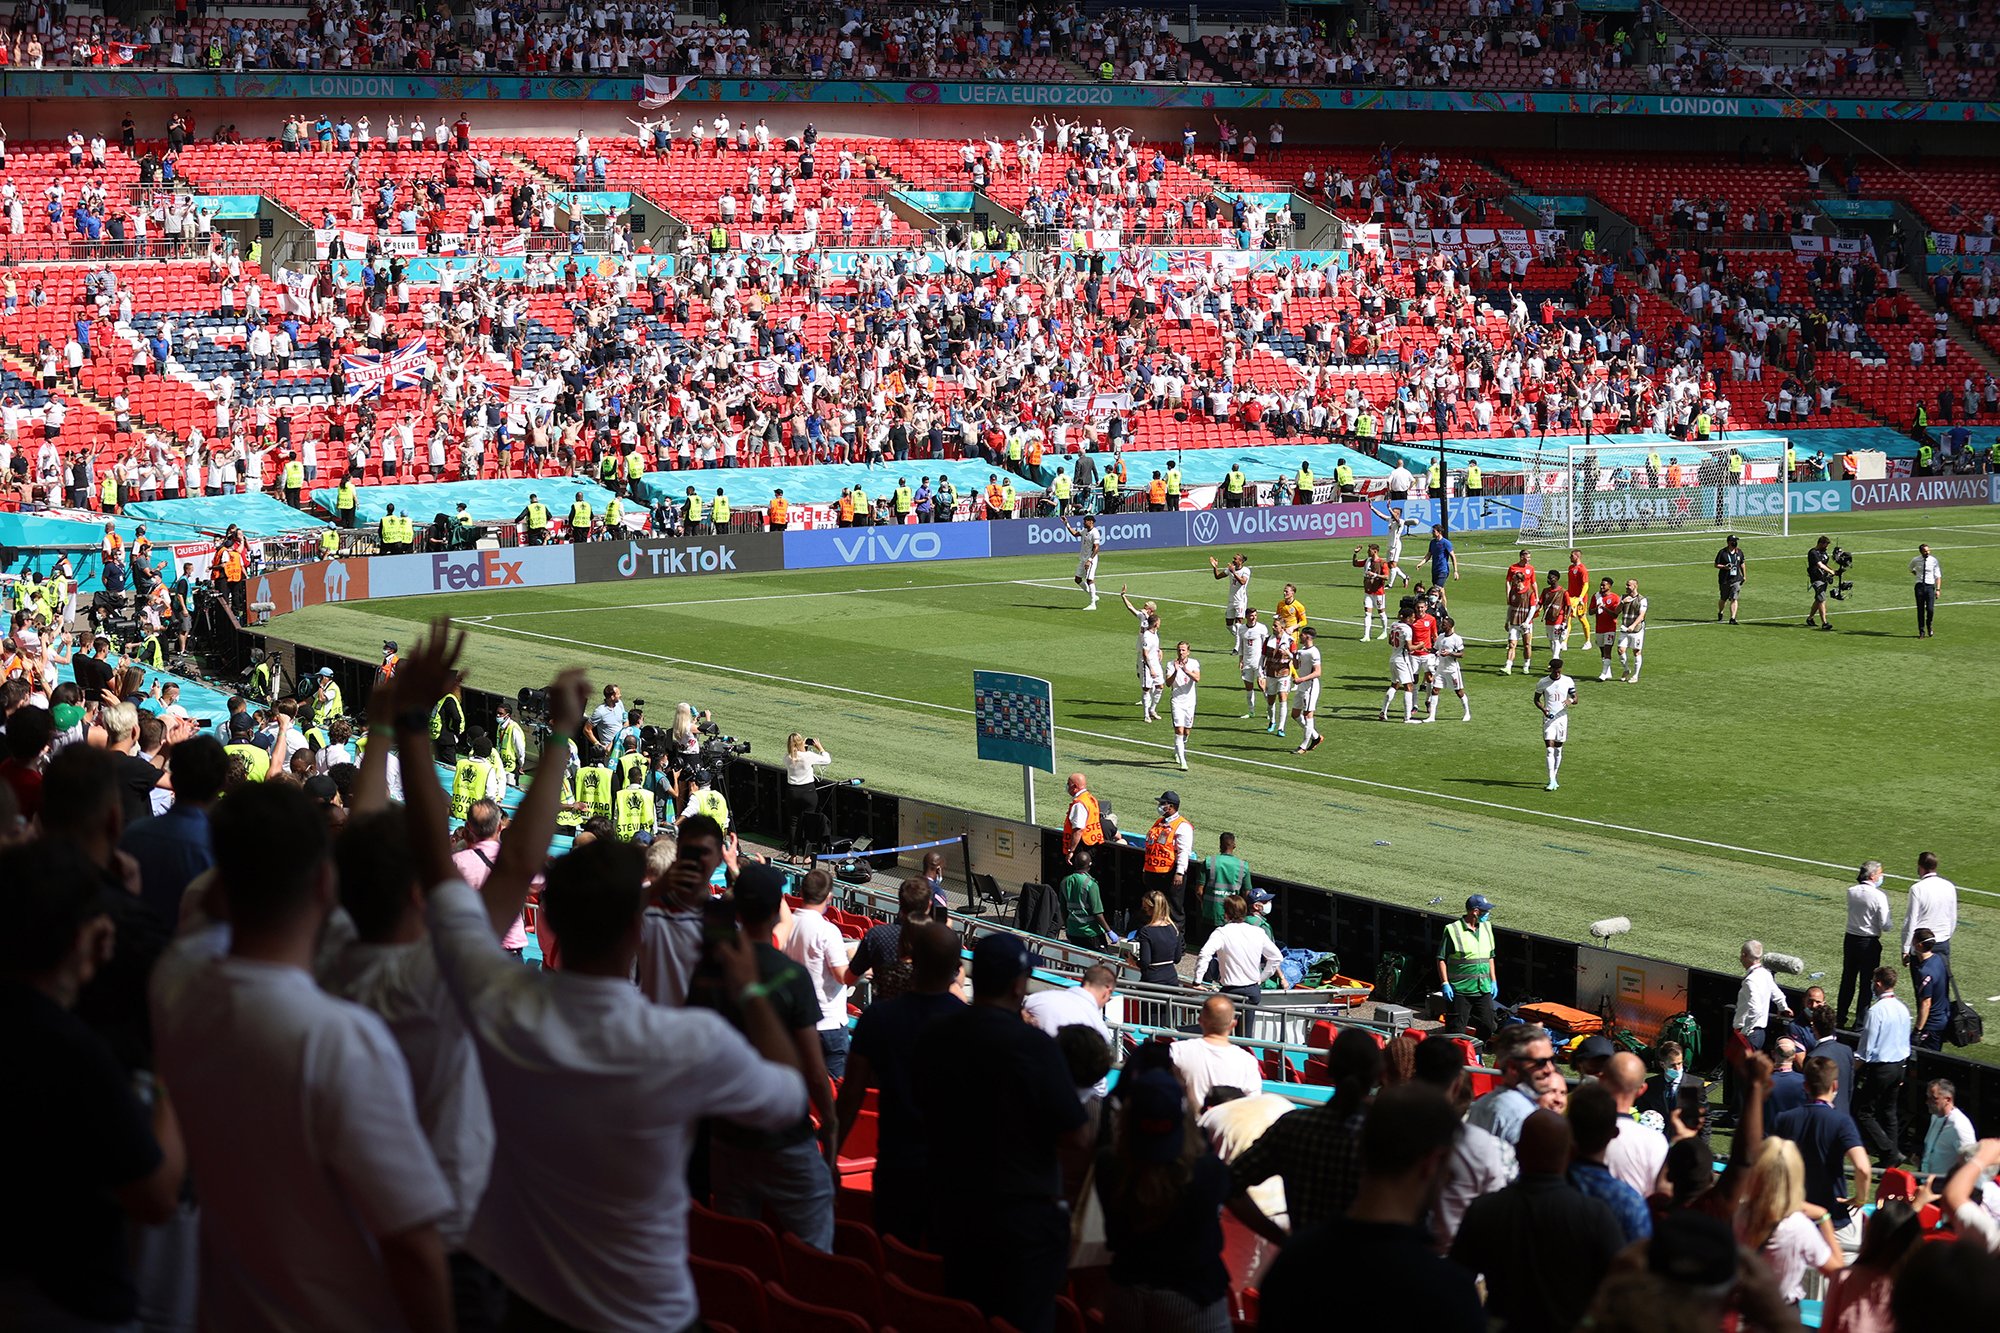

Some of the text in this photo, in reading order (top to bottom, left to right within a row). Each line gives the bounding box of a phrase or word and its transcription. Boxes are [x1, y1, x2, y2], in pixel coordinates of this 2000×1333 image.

[310, 77, 394, 96] LONDON
[959, 85, 1112, 104] UEFA EURO 2020
[1660, 97, 1739, 116] LONDON
[203, 198, 218, 206] 110
[926, 194, 939, 202] 112
[1837, 242, 1854, 250] ARE
[350, 355, 428, 381] SOUTHAMPTON
[1852, 483, 1911, 506] QATAR
[1916, 478, 1988, 502] AIRWAYS
[1227, 509, 1363, 536] Volkswagen
[177, 544, 209, 556] QUEENS
[833, 527, 942, 563] vivo
[648, 545, 737, 575] TikTok
[432, 550, 524, 591] FedEx
[452, 794, 476, 804] TEWAR
[586, 801, 610, 811] WARD
[616, 821, 653, 833] STEWAR
